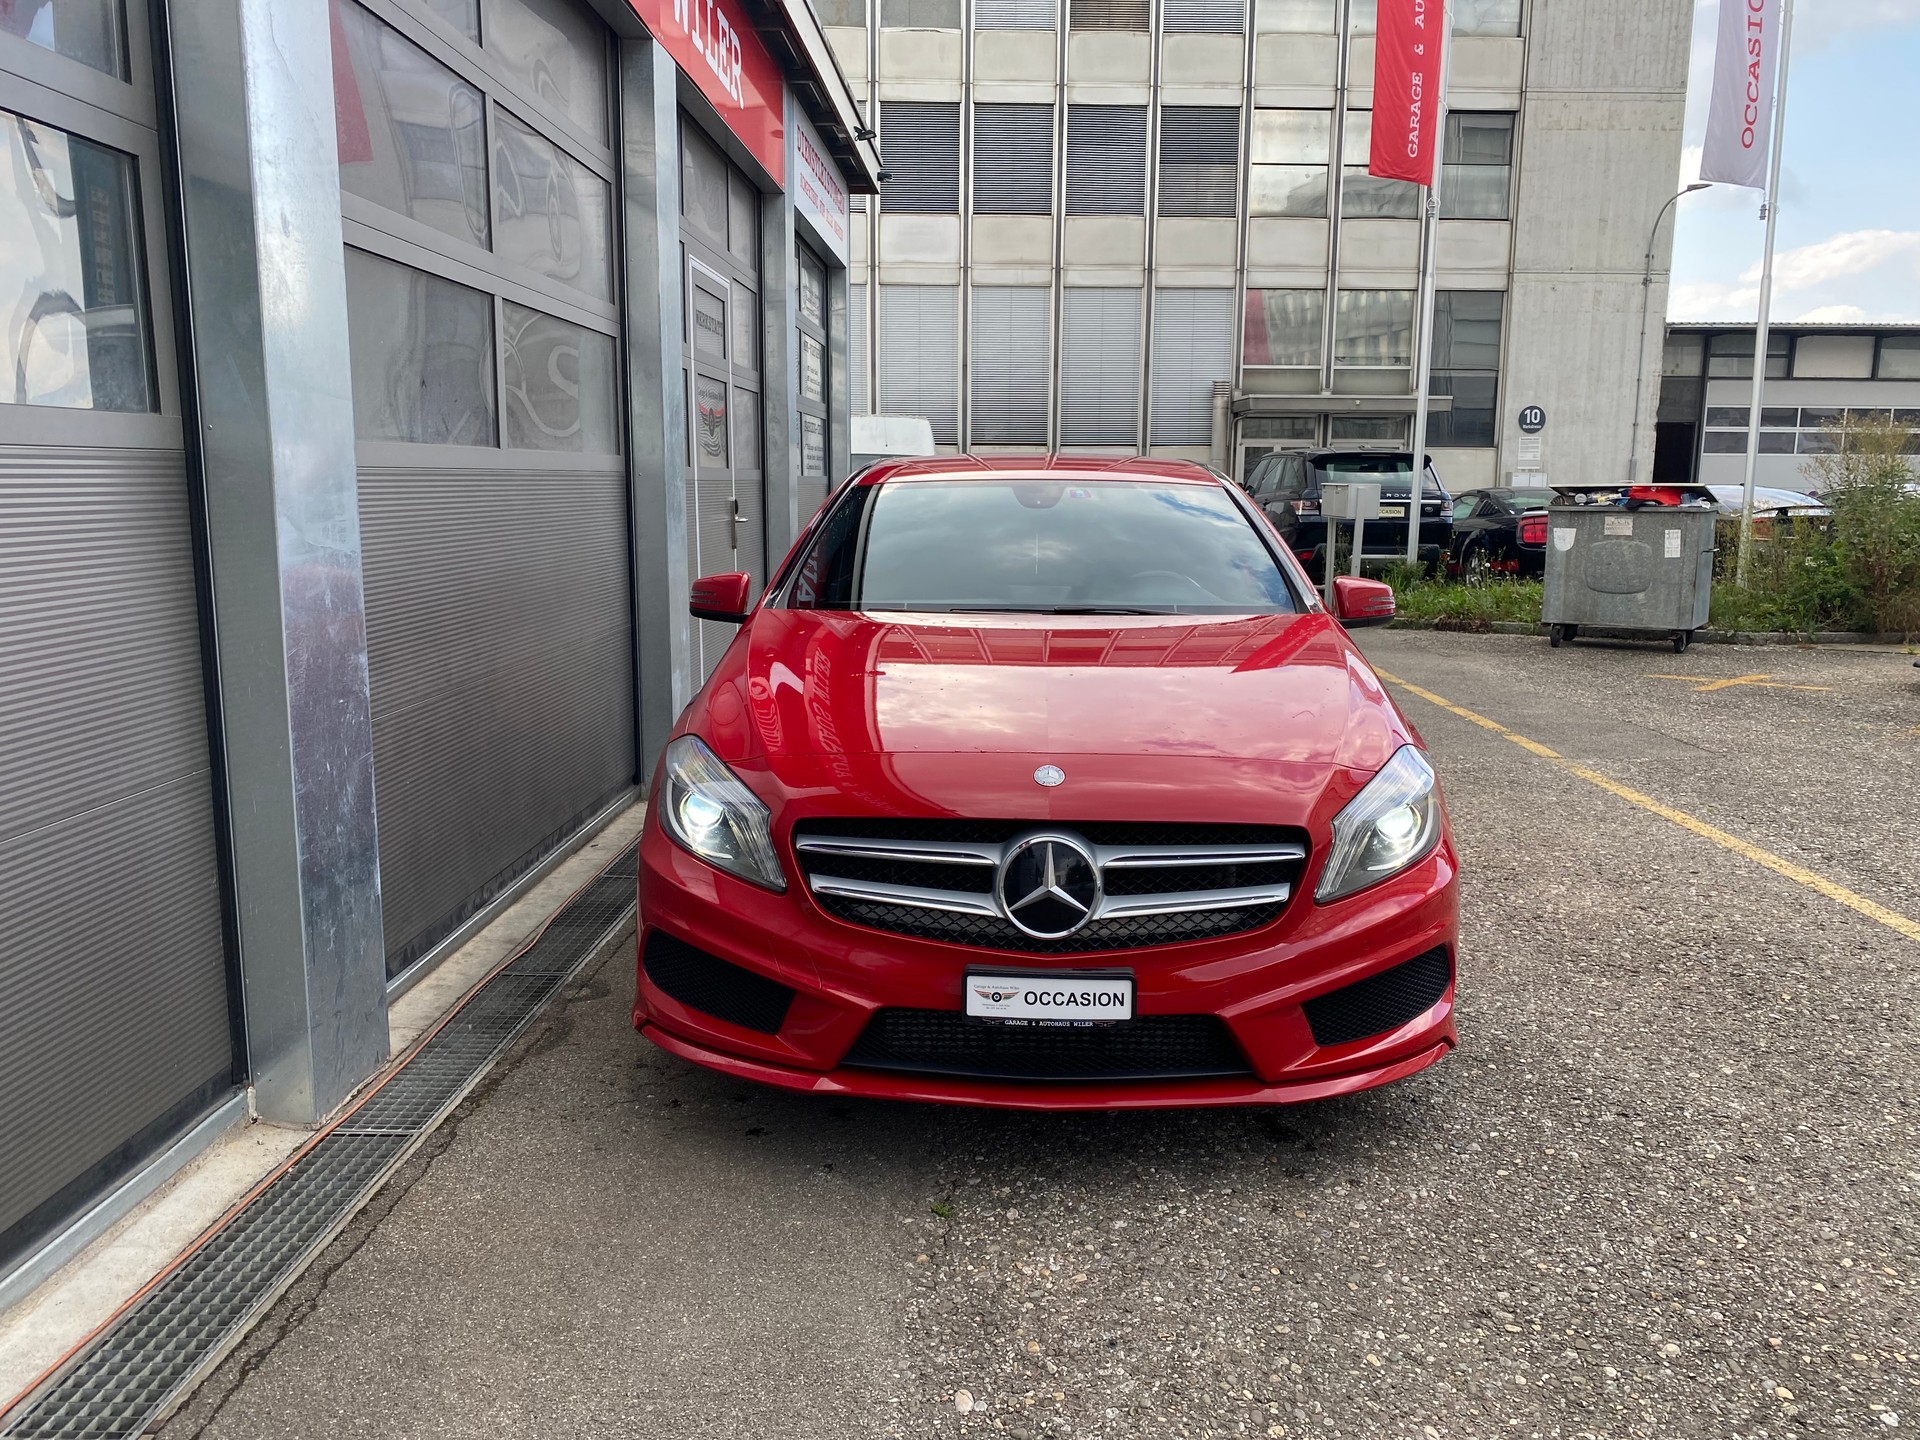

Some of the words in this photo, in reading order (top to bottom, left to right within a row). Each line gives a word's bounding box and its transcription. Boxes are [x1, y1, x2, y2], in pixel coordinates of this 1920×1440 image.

[1414, 43, 1424, 56] &
[1407, 72, 1423, 158] GARAGE
[1524, 409, 1541, 424] 10
[1024, 991, 1125, 1007] OCCASION
